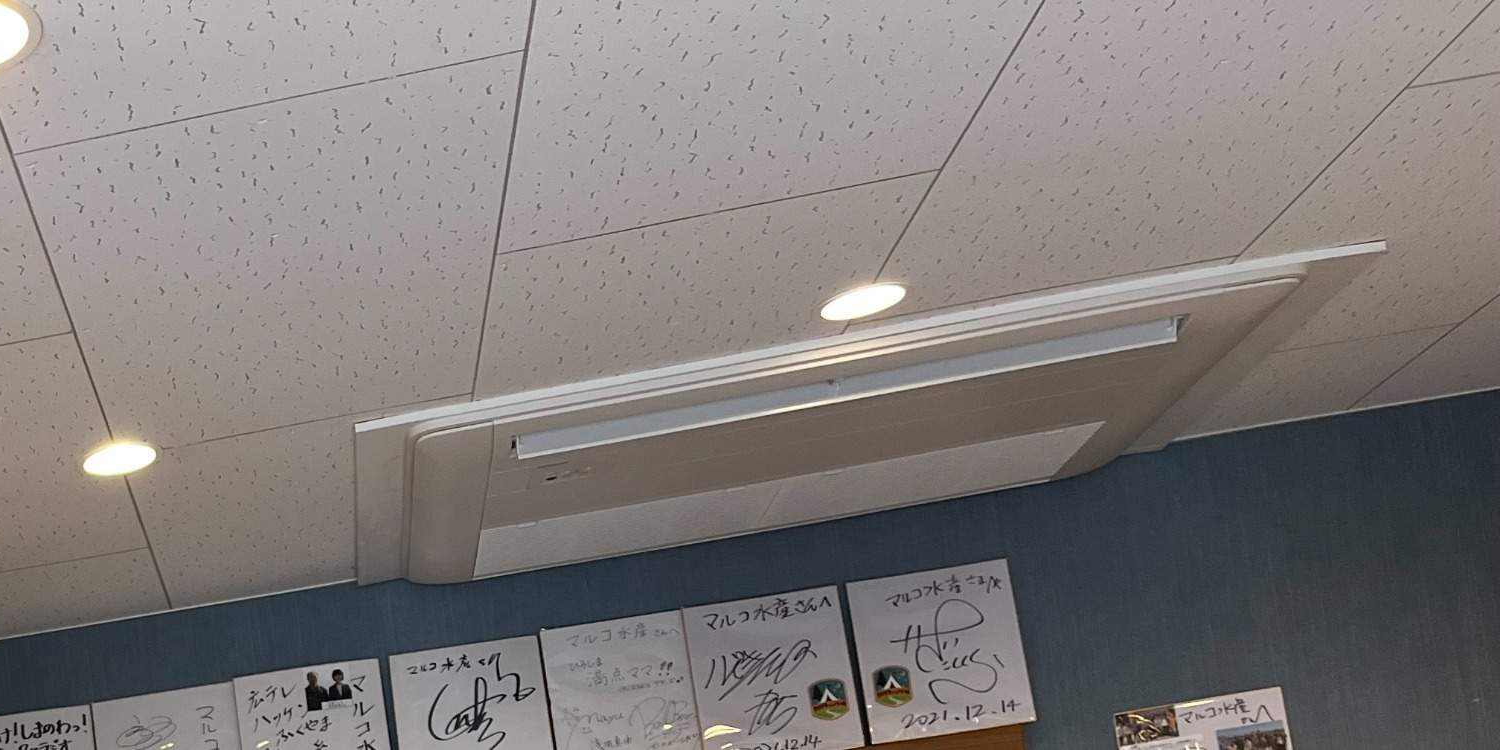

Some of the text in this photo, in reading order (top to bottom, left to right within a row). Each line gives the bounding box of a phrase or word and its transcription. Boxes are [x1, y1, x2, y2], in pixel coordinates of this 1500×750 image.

[703, 596, 833, 630] マルコ水産さんへ
